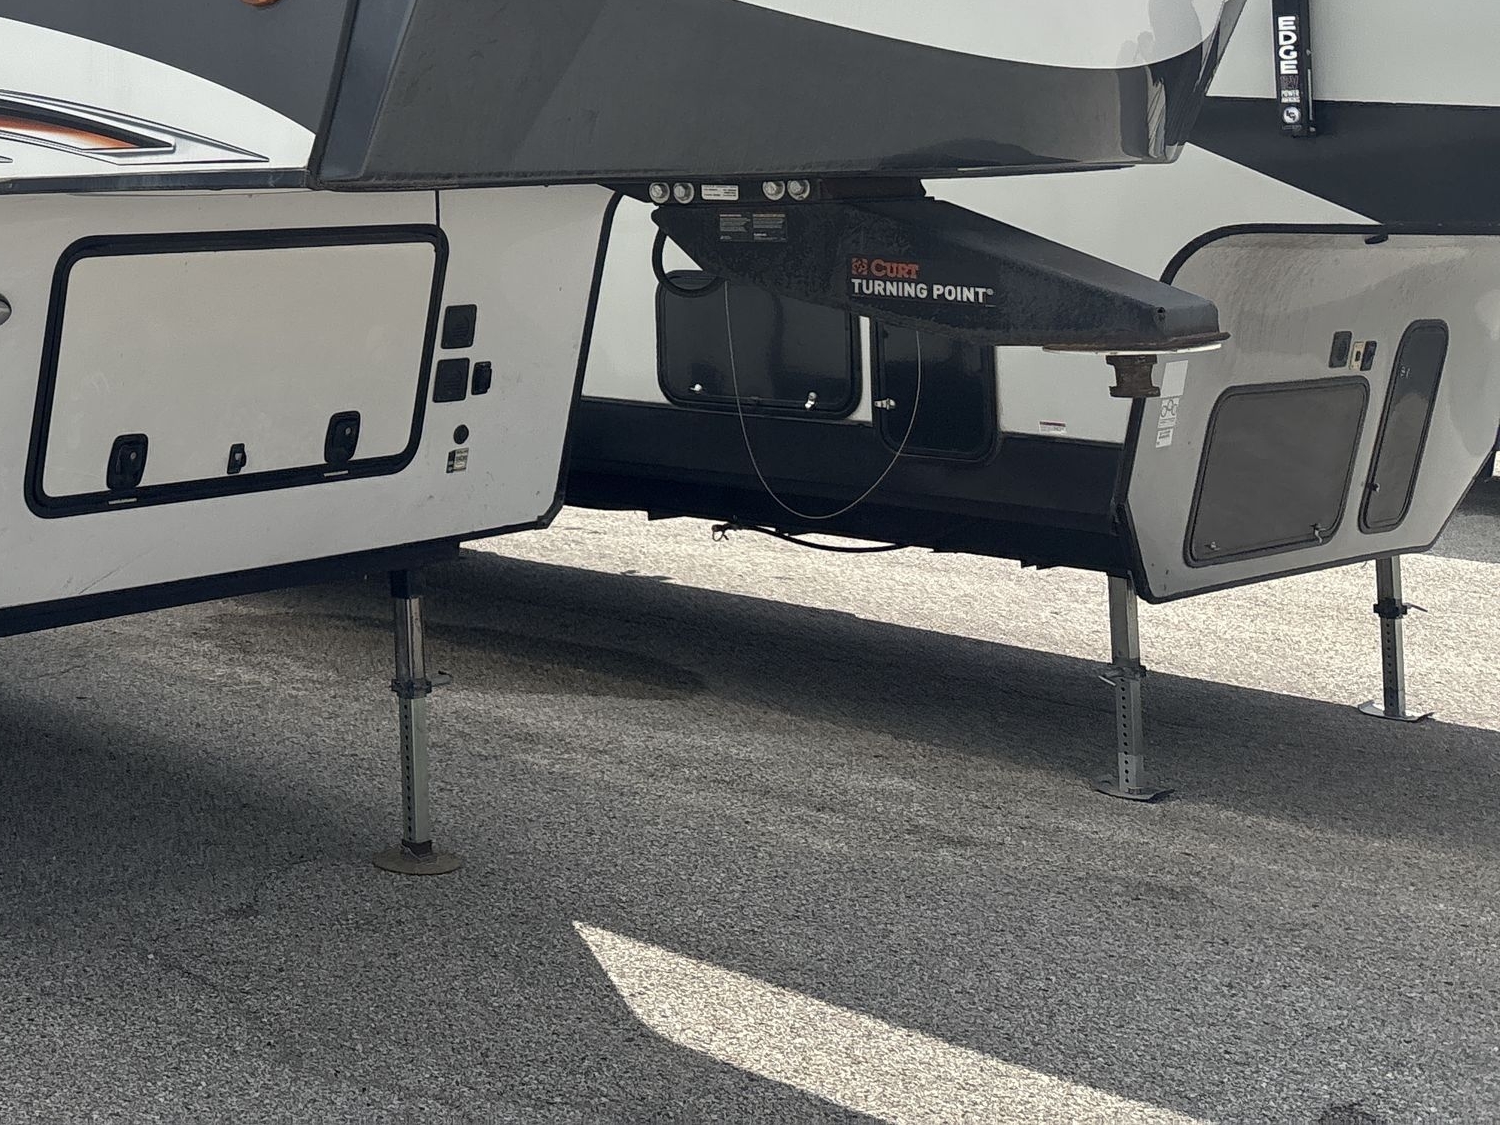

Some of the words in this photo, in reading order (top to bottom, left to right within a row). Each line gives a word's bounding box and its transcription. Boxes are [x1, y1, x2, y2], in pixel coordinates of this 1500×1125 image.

[1277, 15, 1299, 75] EDGE
[870, 259, 919, 279] CURT
[851, 278, 928, 299] TURNING
